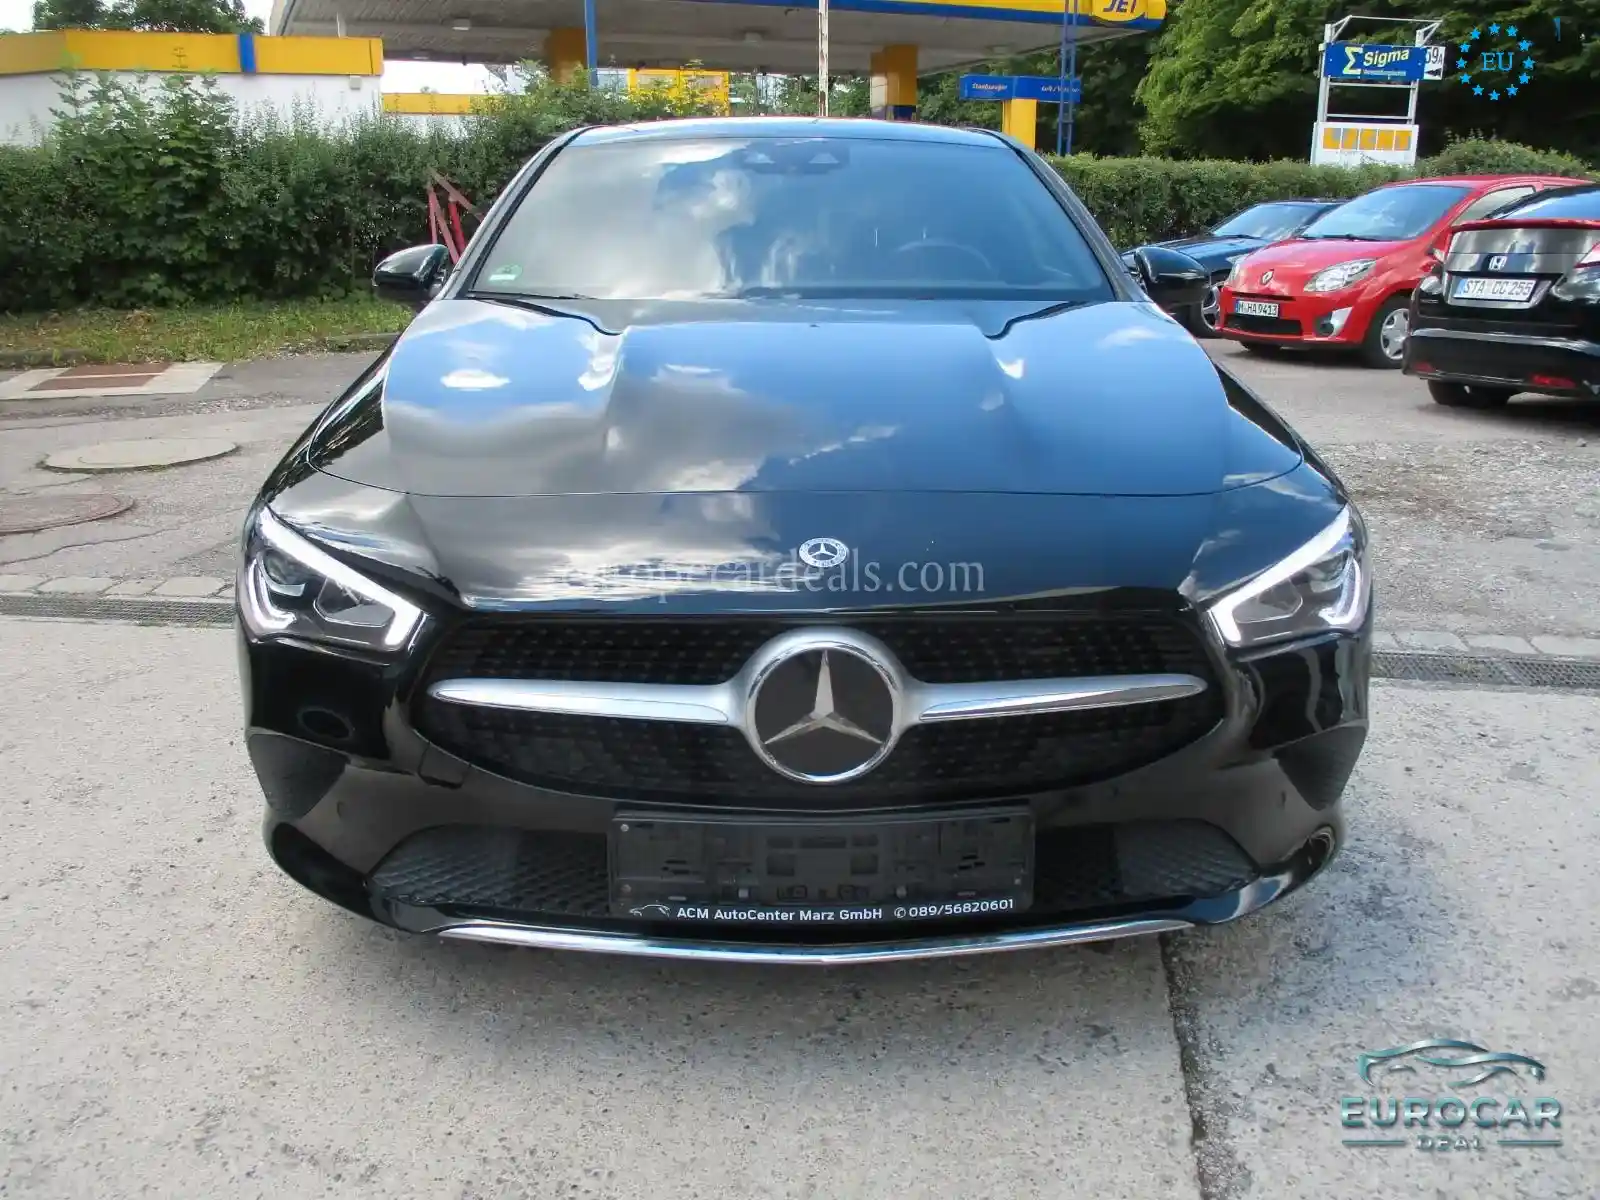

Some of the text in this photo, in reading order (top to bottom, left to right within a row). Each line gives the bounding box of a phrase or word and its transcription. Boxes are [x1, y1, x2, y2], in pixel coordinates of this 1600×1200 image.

[1363, 48, 1410, 65] Sigma
[1463, 280, 1486, 294] STA
[1508, 282, 1534, 296] 255
[676, 898, 1014, 921] ACM AutoCenter Marz GmbH 089/56820601
